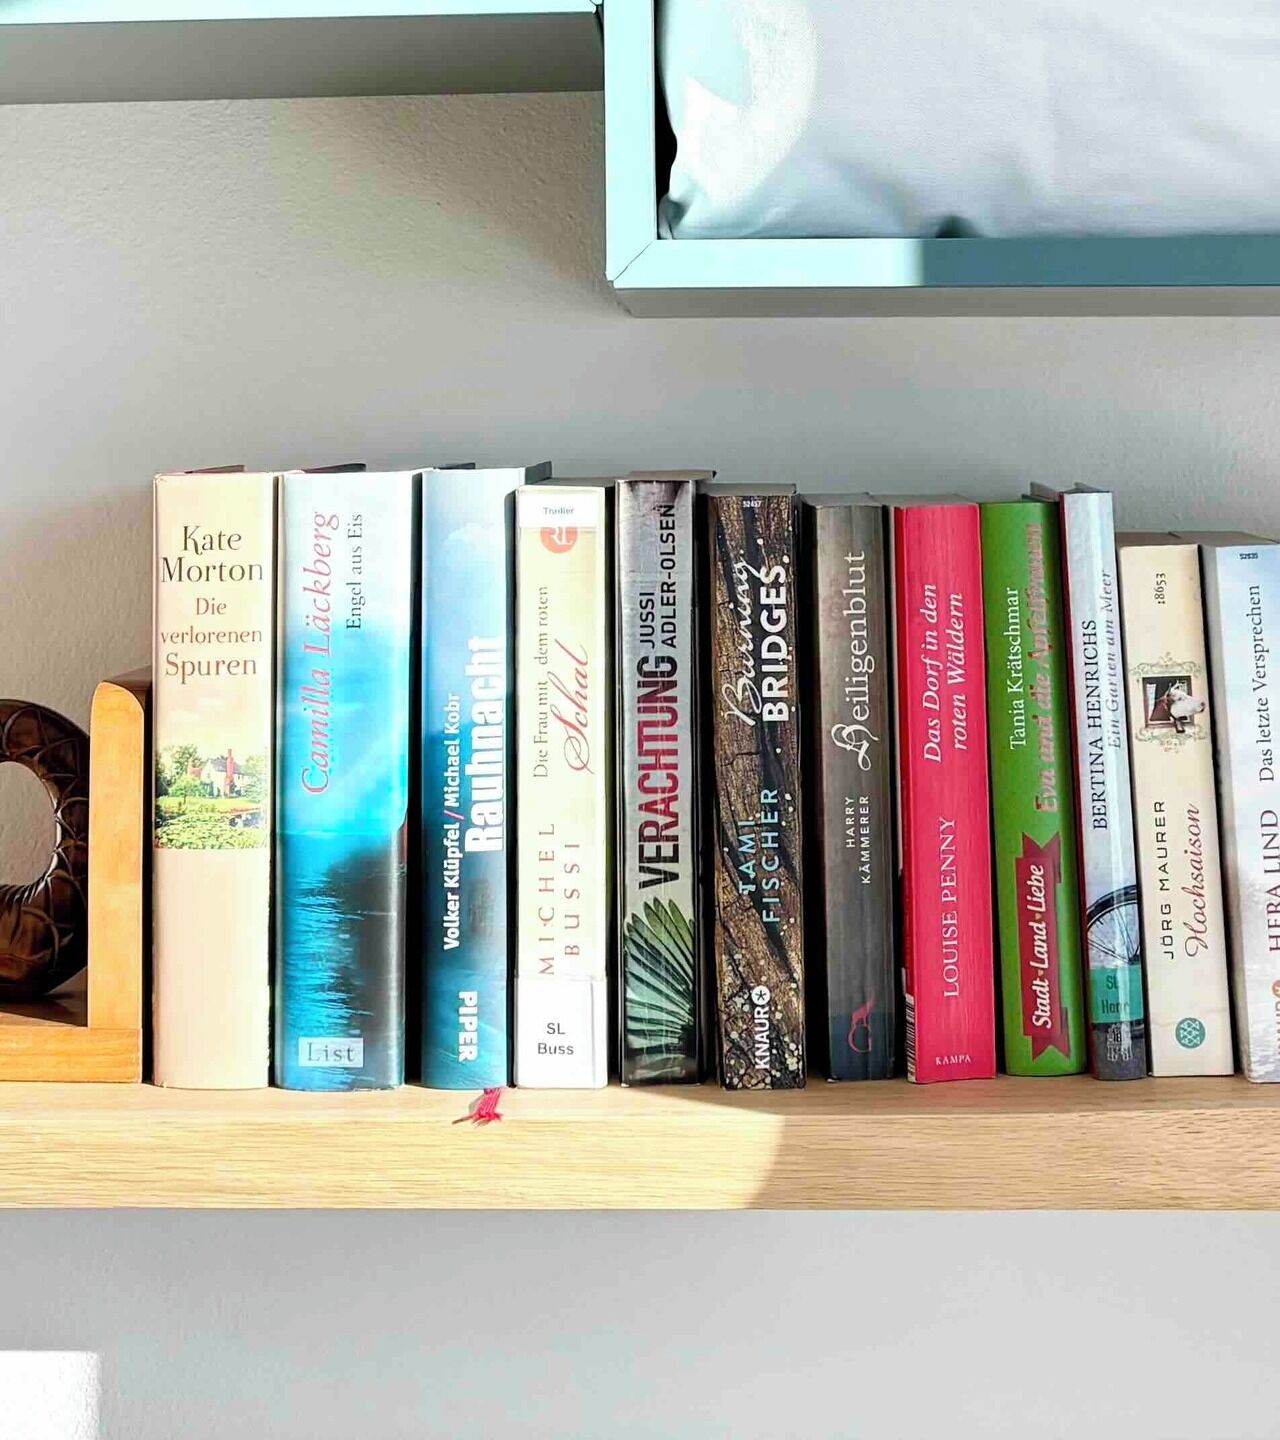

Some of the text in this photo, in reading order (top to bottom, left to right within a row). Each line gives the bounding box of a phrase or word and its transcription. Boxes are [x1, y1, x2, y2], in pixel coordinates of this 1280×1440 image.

[160, 556, 263, 583] Morton
[182, 524, 242, 555] Kate
[345, 513, 366, 630] Engel aus Eis
[660, 504, 677, 649] ADLER-OLSEN
[160, 625, 262, 645] verlorenen
[195, 597, 227, 616] Die
[302, 511, 340, 795] Camilla Läckberg
[639, 591, 655, 649] JUSSI
[722, 556, 768, 727] Burning
[760, 565, 789, 722] BRIDGES
[831, 550, 879, 771] Heiligenblut
[1100, 569, 1121, 749] Ein Garten am Meer
[1246, 584, 1271, 692] Versprechen
[165, 652, 257, 684] Spuren
[444, 694, 462, 733] Kobr
[533, 586, 548, 778] Die Frau mit dem roten
[547, 638, 595, 775] Schal
[920, 584, 944, 763] Das Dorf in den
[945, 592, 967, 751] roten Wäldern
[1003, 587, 1026, 751] Tania Krätschmar
[1252, 697, 1272, 744] letzte
[444, 738, 462, 807] Michael
[465, 635, 505, 852] Rauhnacht
[637, 656, 679, 890] VERACHTUNG
[1081, 619, 1108, 830] BERTINA HENRICHS
[1258, 748, 1275, 782] Das
[442, 819, 464, 880] Klüpfel
[738, 819, 757, 894] TAMI
[761, 789, 780, 923] FISCHER
[845, 796, 855, 848] HARRY
[857, 795, 871, 884] KÄMMERER
[443, 883, 462, 950] Volker
[538, 823, 555, 975] MICHEL
[564, 843, 580, 956] BUSSI
[939, 816, 960, 998] LOUISE PENNY
[1154, 800, 1174, 960] JÖRG MAURER
[1181, 803, 1209, 958] Hochsaison
[306, 1043, 355, 1063] List
[457, 990, 479, 1063] PIPER
[537, 1042, 574, 1056] Buss
[546, 1022, 566, 1035] SL
[754, 1004, 771, 1070] KNAUR
[935, 1054, 972, 1066] KAMPA
